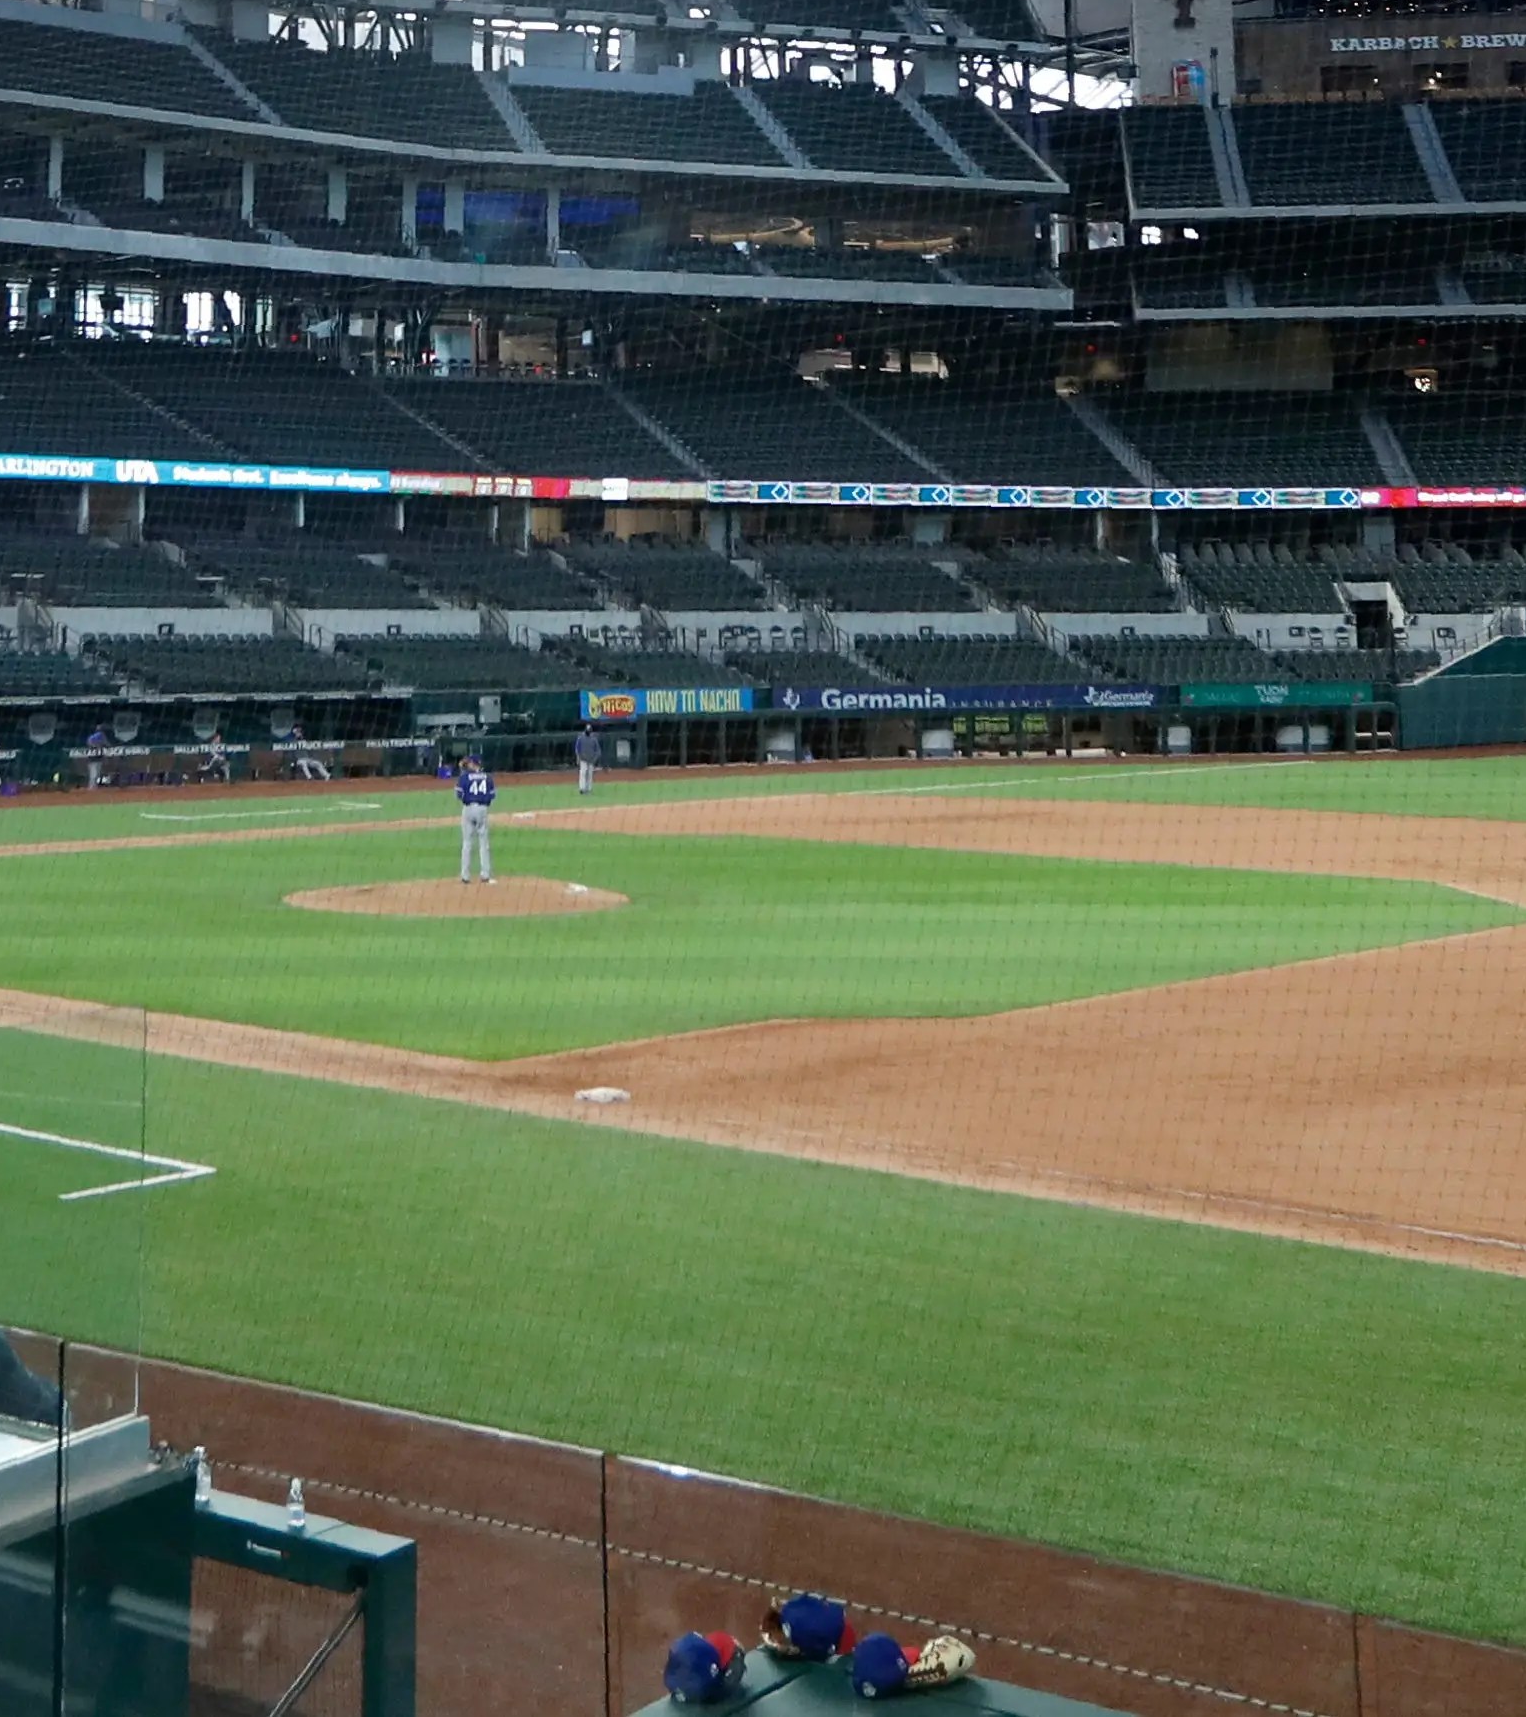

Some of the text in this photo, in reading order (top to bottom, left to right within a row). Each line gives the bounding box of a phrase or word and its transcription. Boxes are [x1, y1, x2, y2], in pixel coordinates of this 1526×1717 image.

[1330, 35, 1439, 52] KARBACH
[646, 689, 678, 713] HOW
[682, 689, 697, 713] TO
[821, 687, 947, 710] Germania
[469, 779, 487, 796] 44
